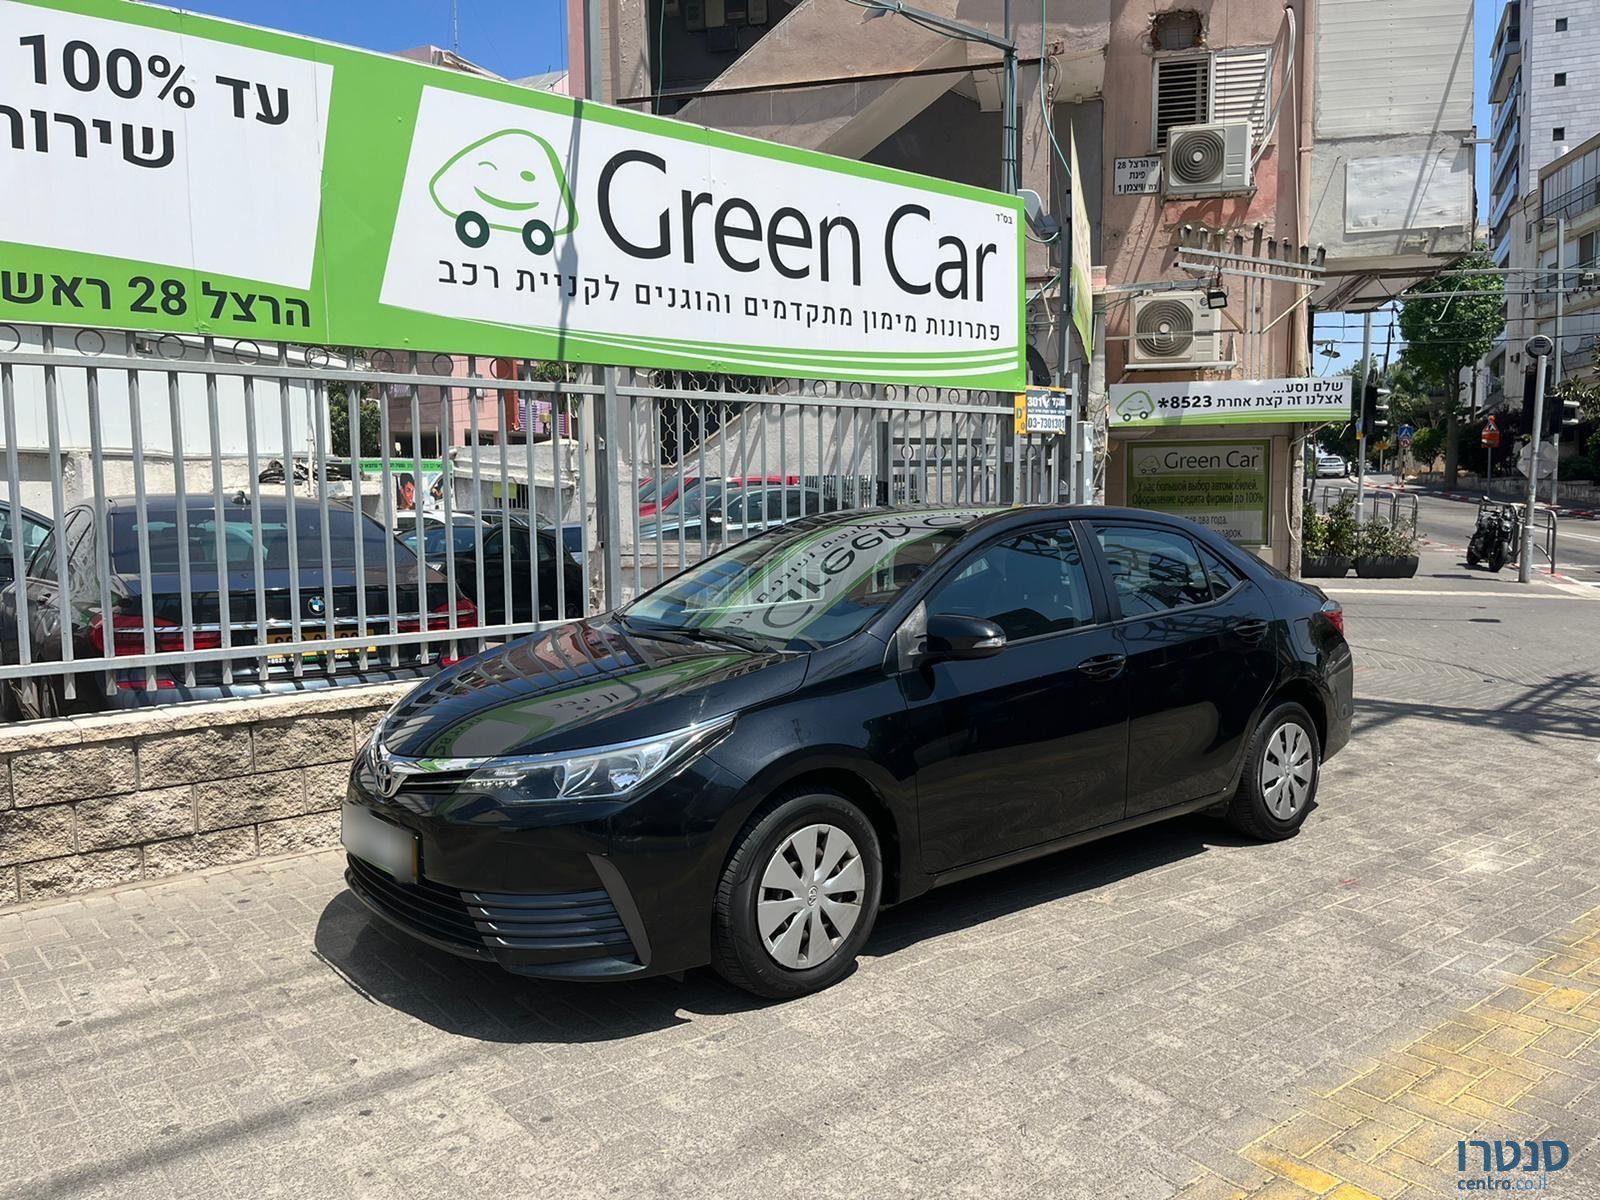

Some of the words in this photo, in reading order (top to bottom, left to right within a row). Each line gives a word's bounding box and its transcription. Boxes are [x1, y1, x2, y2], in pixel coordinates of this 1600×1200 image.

[20, 33, 196, 109] 100%
[215, 74, 289, 125] עד
[1117, 161, 1126, 169] 28
[1129, 160, 1149, 168] הרצל
[1129, 171, 1145, 179] פינת
[597, 149, 862, 287] Green
[884, 203, 997, 302] Car
[438, 259, 500, 289] רכב
[1, 270, 111, 311] ראש
[128, 275, 188, 316] 28
[515, 268, 620, 306] לקניית
[634, 282, 732, 315] והוגנים
[201, 281, 310, 327] הרצל
[744, 296, 853, 328] מתקדמים
[862, 309, 917, 334] מימון
[925, 317, 1001, 341] פתרונות
[1272, 382, 1309, 394] וסע...
[1313, 380, 1343, 393] שלם
[1216, 397, 1252, 408] אחרת
[1255, 396, 1283, 409] קצת
[1287, 395, 1302, 406] זה
[1306, 393, 1343, 405] אצלנו
[1164, 451, 1222, 469] Green
[1226, 450, 1260, 468] Car
